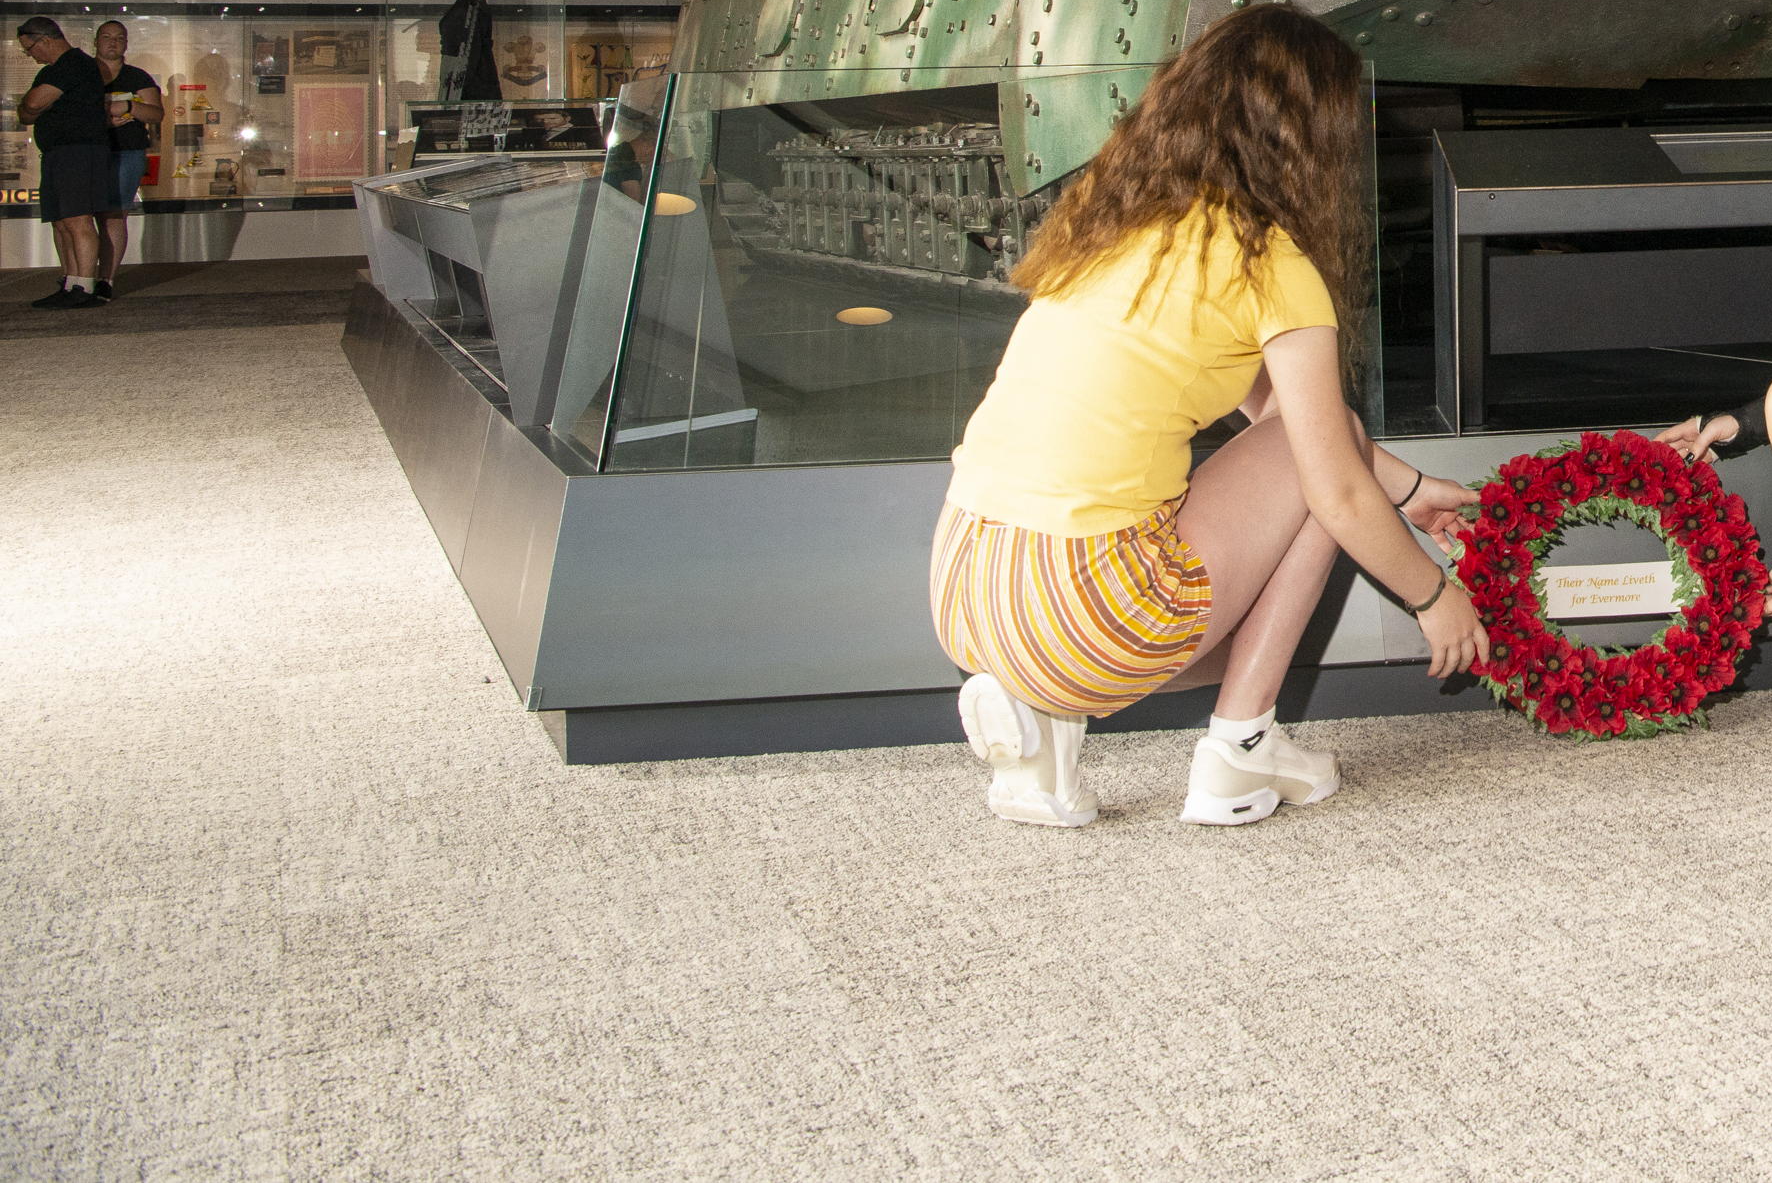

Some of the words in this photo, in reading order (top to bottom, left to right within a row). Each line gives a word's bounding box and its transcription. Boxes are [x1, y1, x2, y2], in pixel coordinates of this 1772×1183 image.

[0, 188, 40, 203] ICE
[1556, 577, 1584, 589] Their
[1587, 576, 1620, 589] Name
[1622, 573, 1656, 586] Liveth
[1570, 594, 1587, 608] for
[1590, 593, 1641, 604] Evermore
